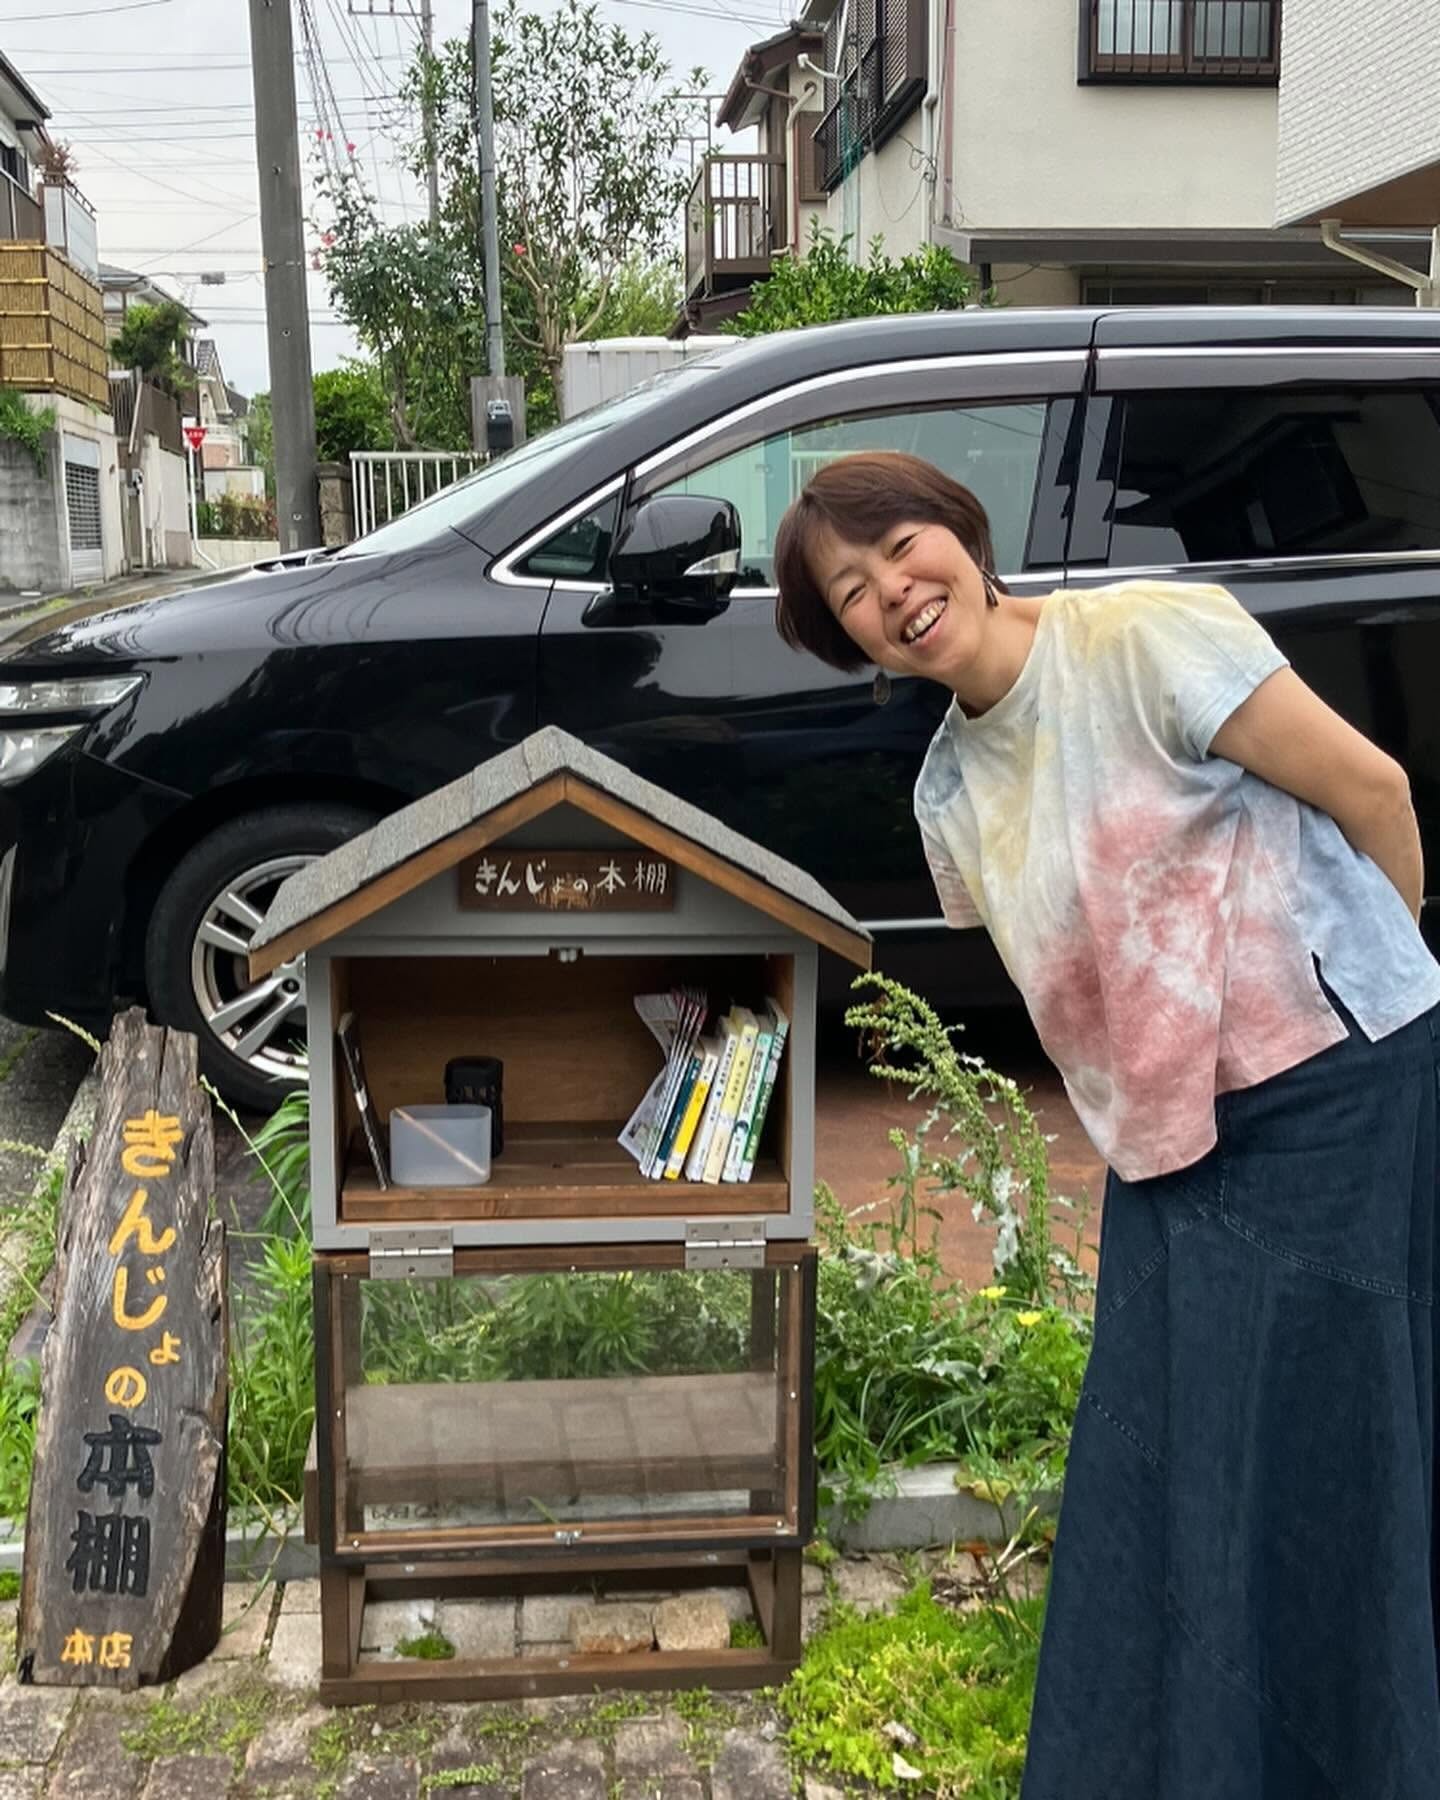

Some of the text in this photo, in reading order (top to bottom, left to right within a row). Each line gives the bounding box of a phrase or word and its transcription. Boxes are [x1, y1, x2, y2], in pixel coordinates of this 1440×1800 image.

[66, 1109, 183, 1597] きんじょの本棚
[61, 1628, 133, 1669] 本店
